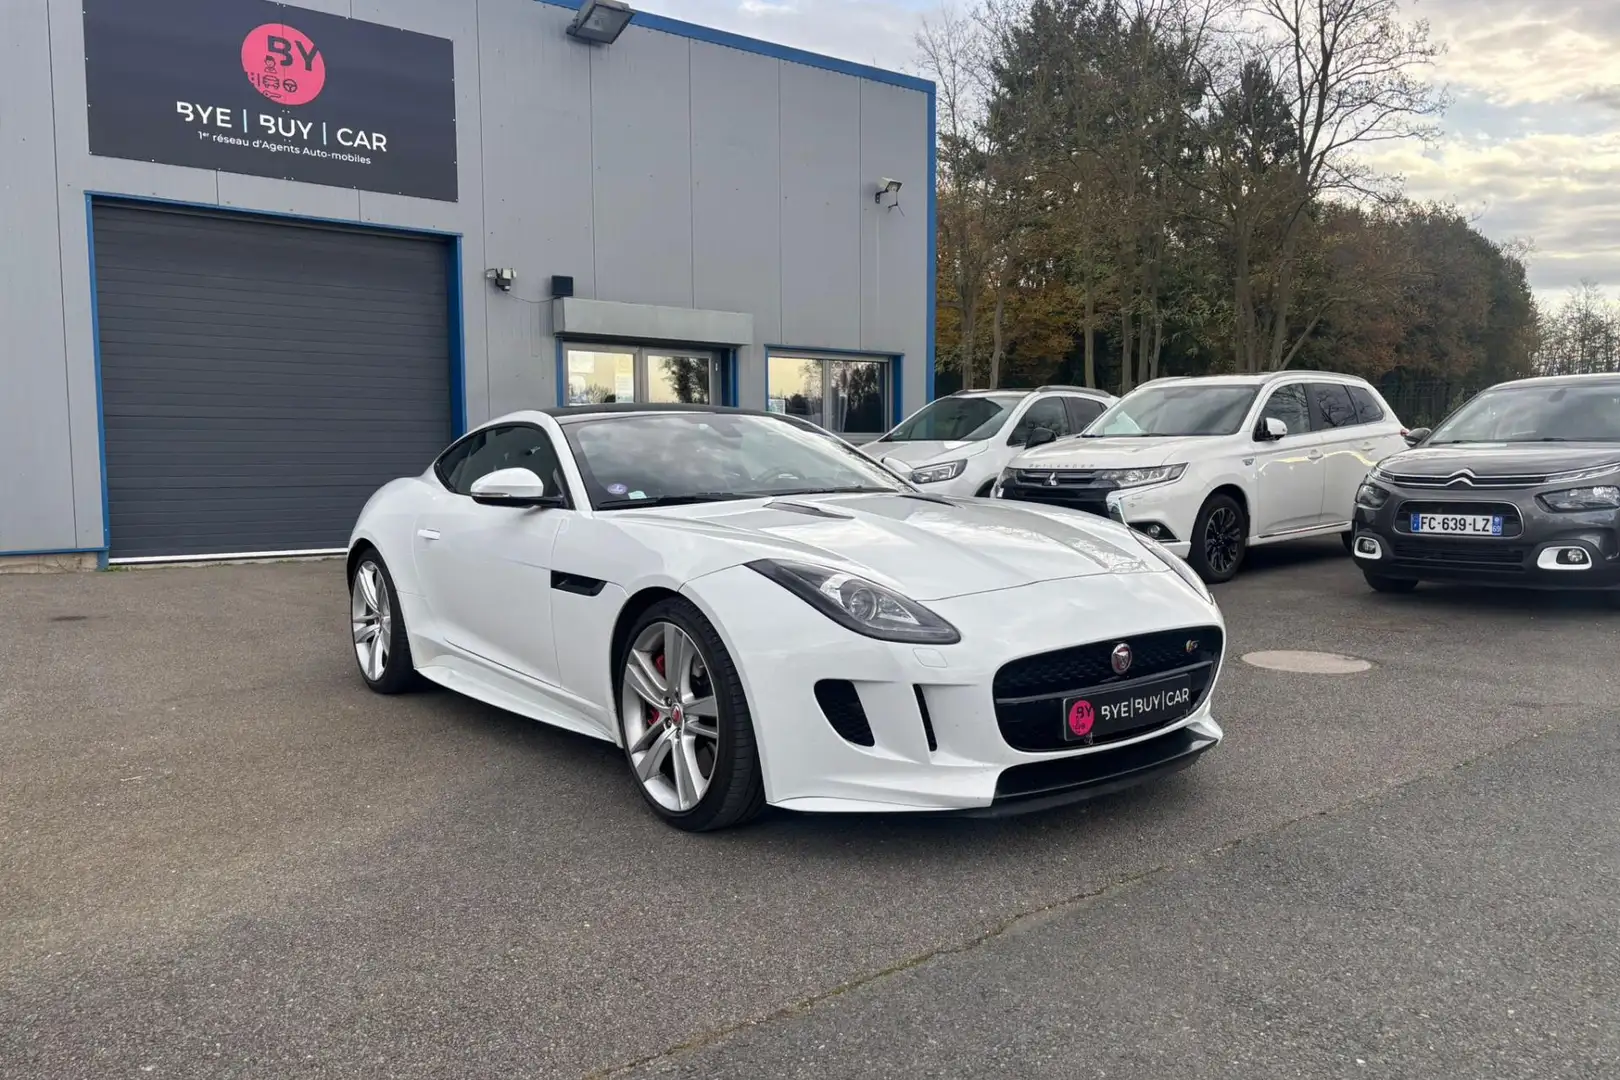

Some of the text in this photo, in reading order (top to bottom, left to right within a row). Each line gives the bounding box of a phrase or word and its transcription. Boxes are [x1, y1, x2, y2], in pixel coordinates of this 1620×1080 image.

[267, 35, 319, 71] BY
[176, 101, 387, 152] BYE BUY CAR
[197, 130, 372, 165] 1er réseau d'Agents Auto-mobiles
[1421, 516, 1490, 532] FC-639-LZ
[1101, 688, 1190, 720] BYE BUY CAR
